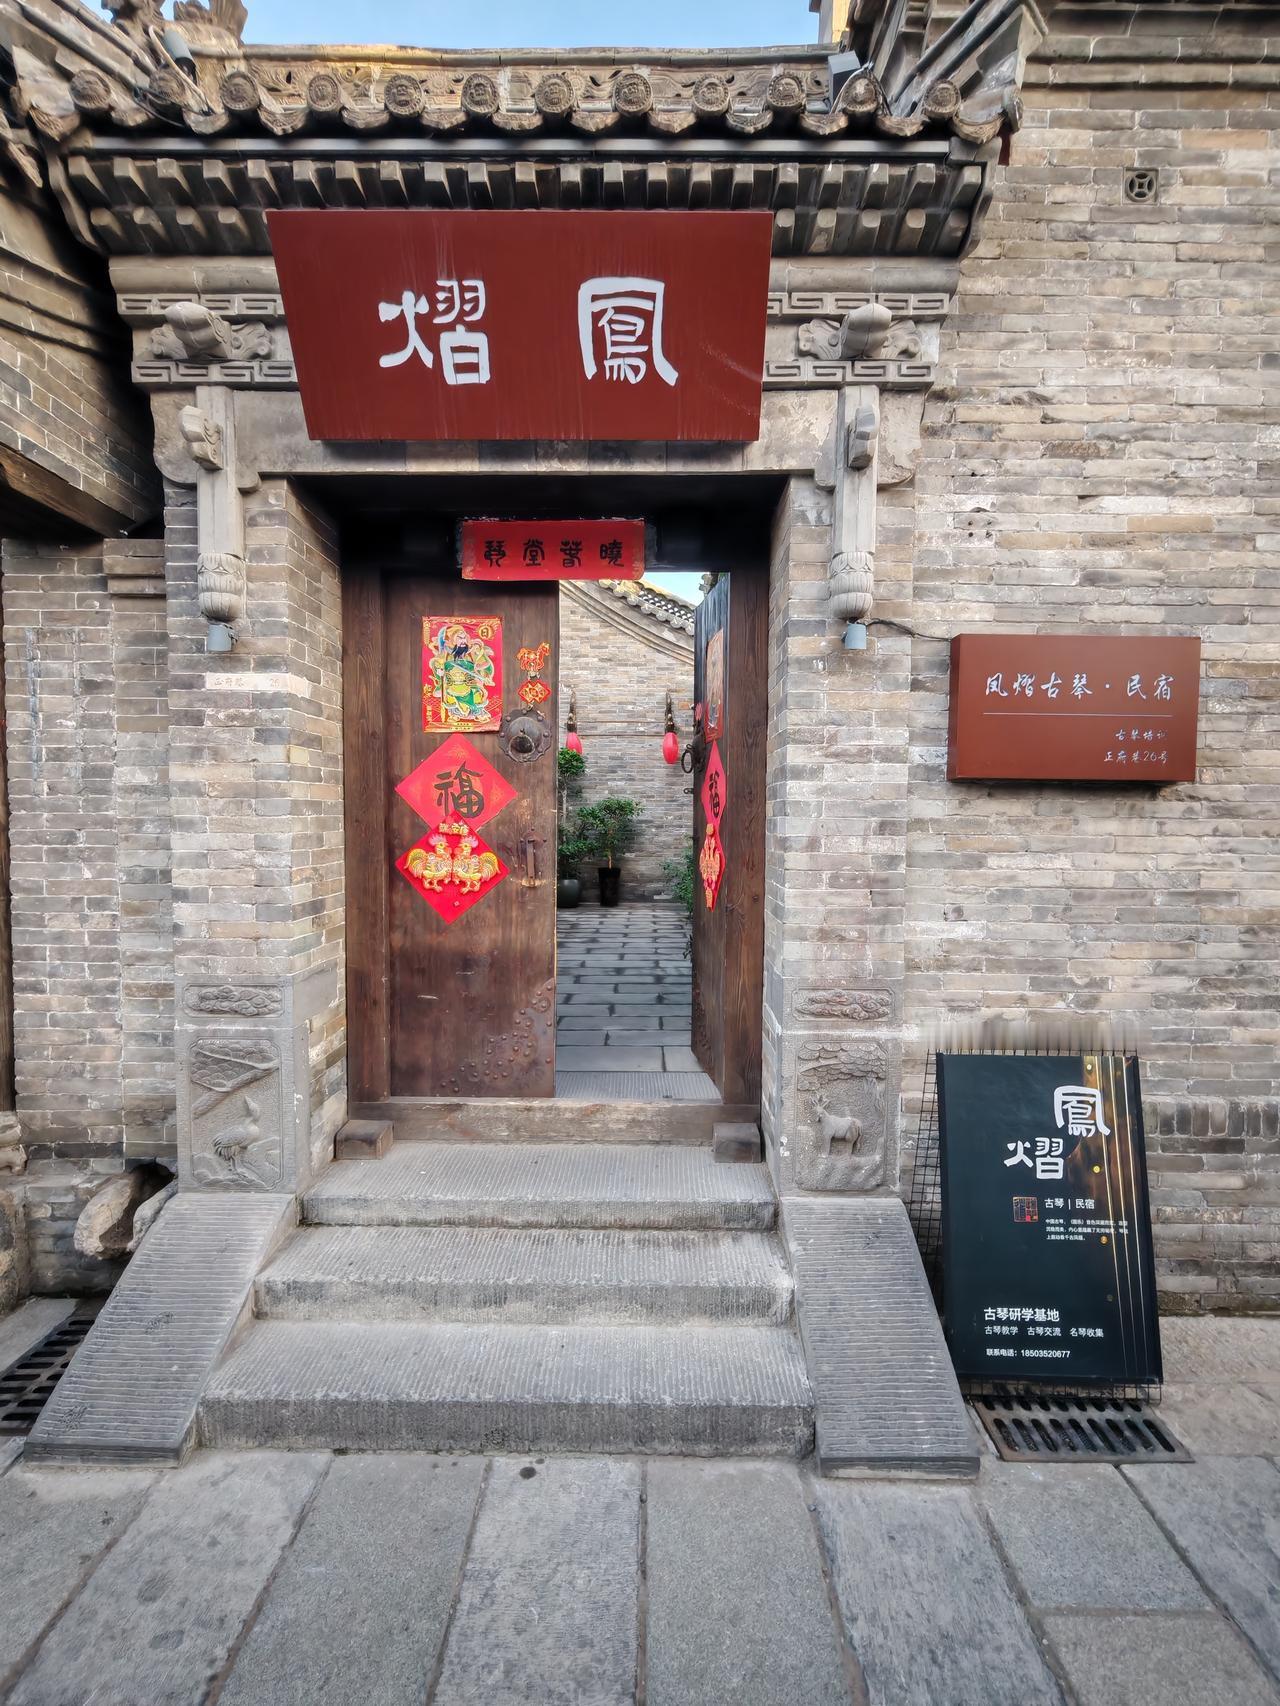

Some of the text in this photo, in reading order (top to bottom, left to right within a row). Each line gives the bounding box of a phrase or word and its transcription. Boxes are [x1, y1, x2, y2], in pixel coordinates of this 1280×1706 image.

[434, 760, 484, 818] 福
[983, 1306, 1060, 1322] 古琴研学基地
[984, 1325, 1104, 1338] 古琴教学 古琴交流 名琴收集
